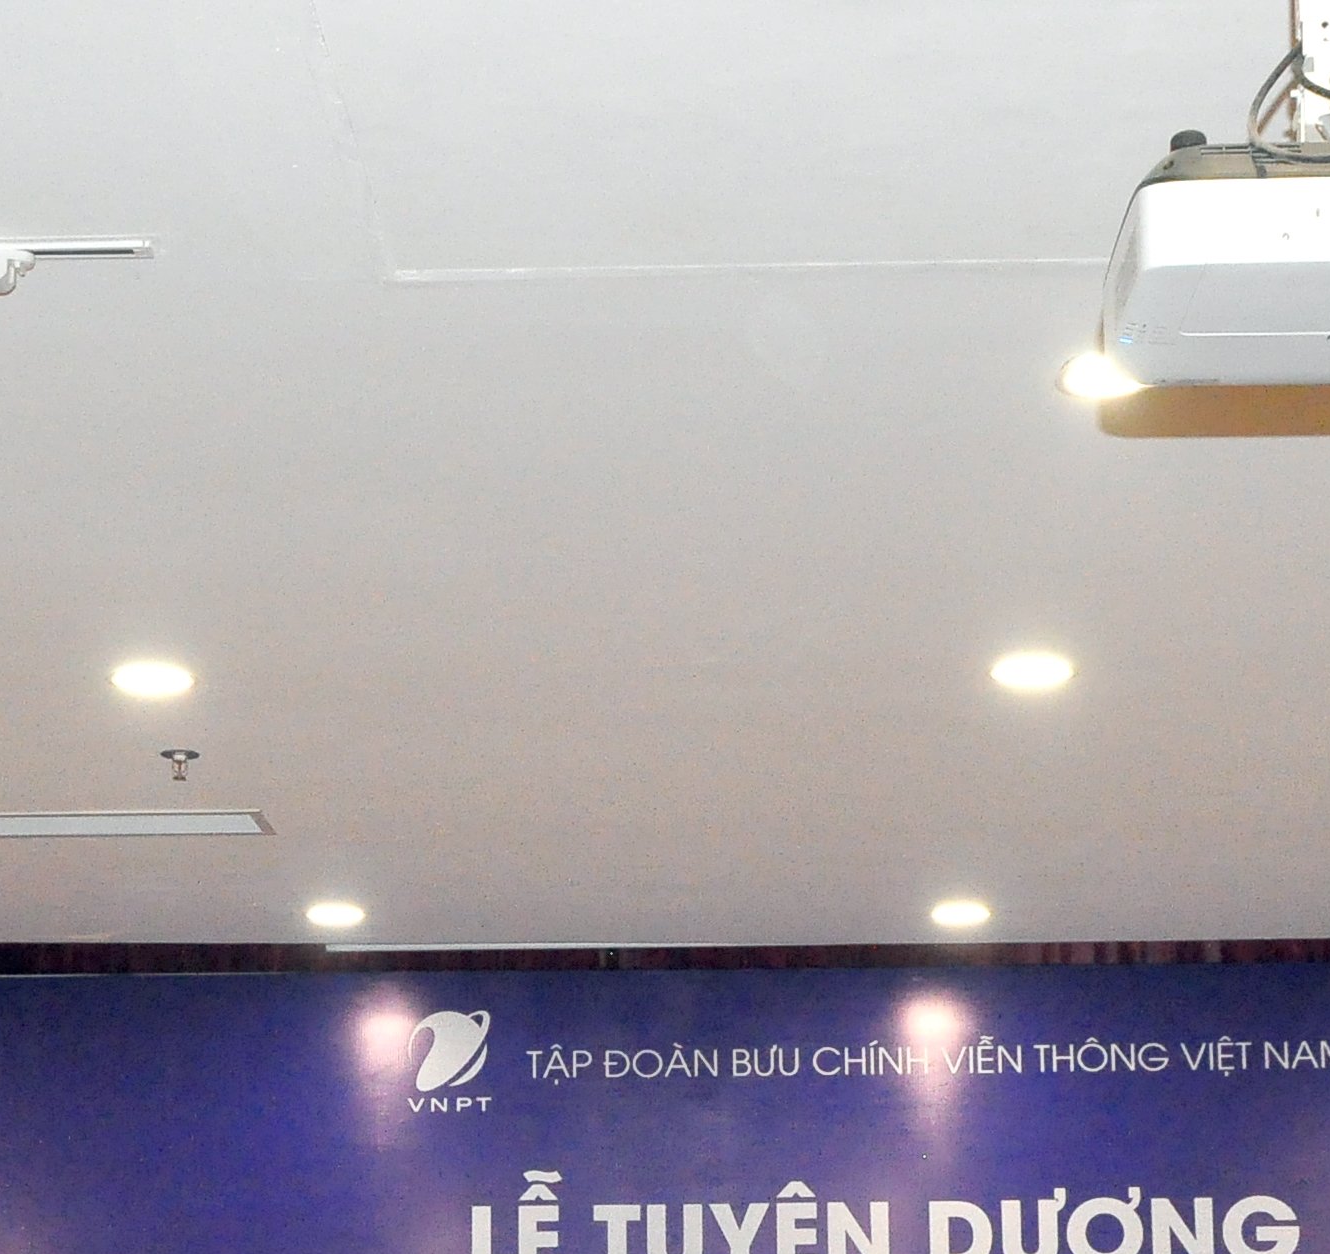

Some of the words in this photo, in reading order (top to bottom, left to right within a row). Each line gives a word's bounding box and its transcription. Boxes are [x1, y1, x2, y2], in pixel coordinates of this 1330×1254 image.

[526, 1043, 593, 1085] TẬP
[603, 1042, 719, 1079] ĐOÀN
[732, 1043, 801, 1078] BƯU
[812, 1040, 930, 1076] CHÍNH
[942, 1035, 1023, 1075] VIỄN
[1033, 1036, 1169, 1073] THÔNG
[1180, 1035, 1253, 1077] VIỆT
[407, 1096, 493, 1113] VNPT
